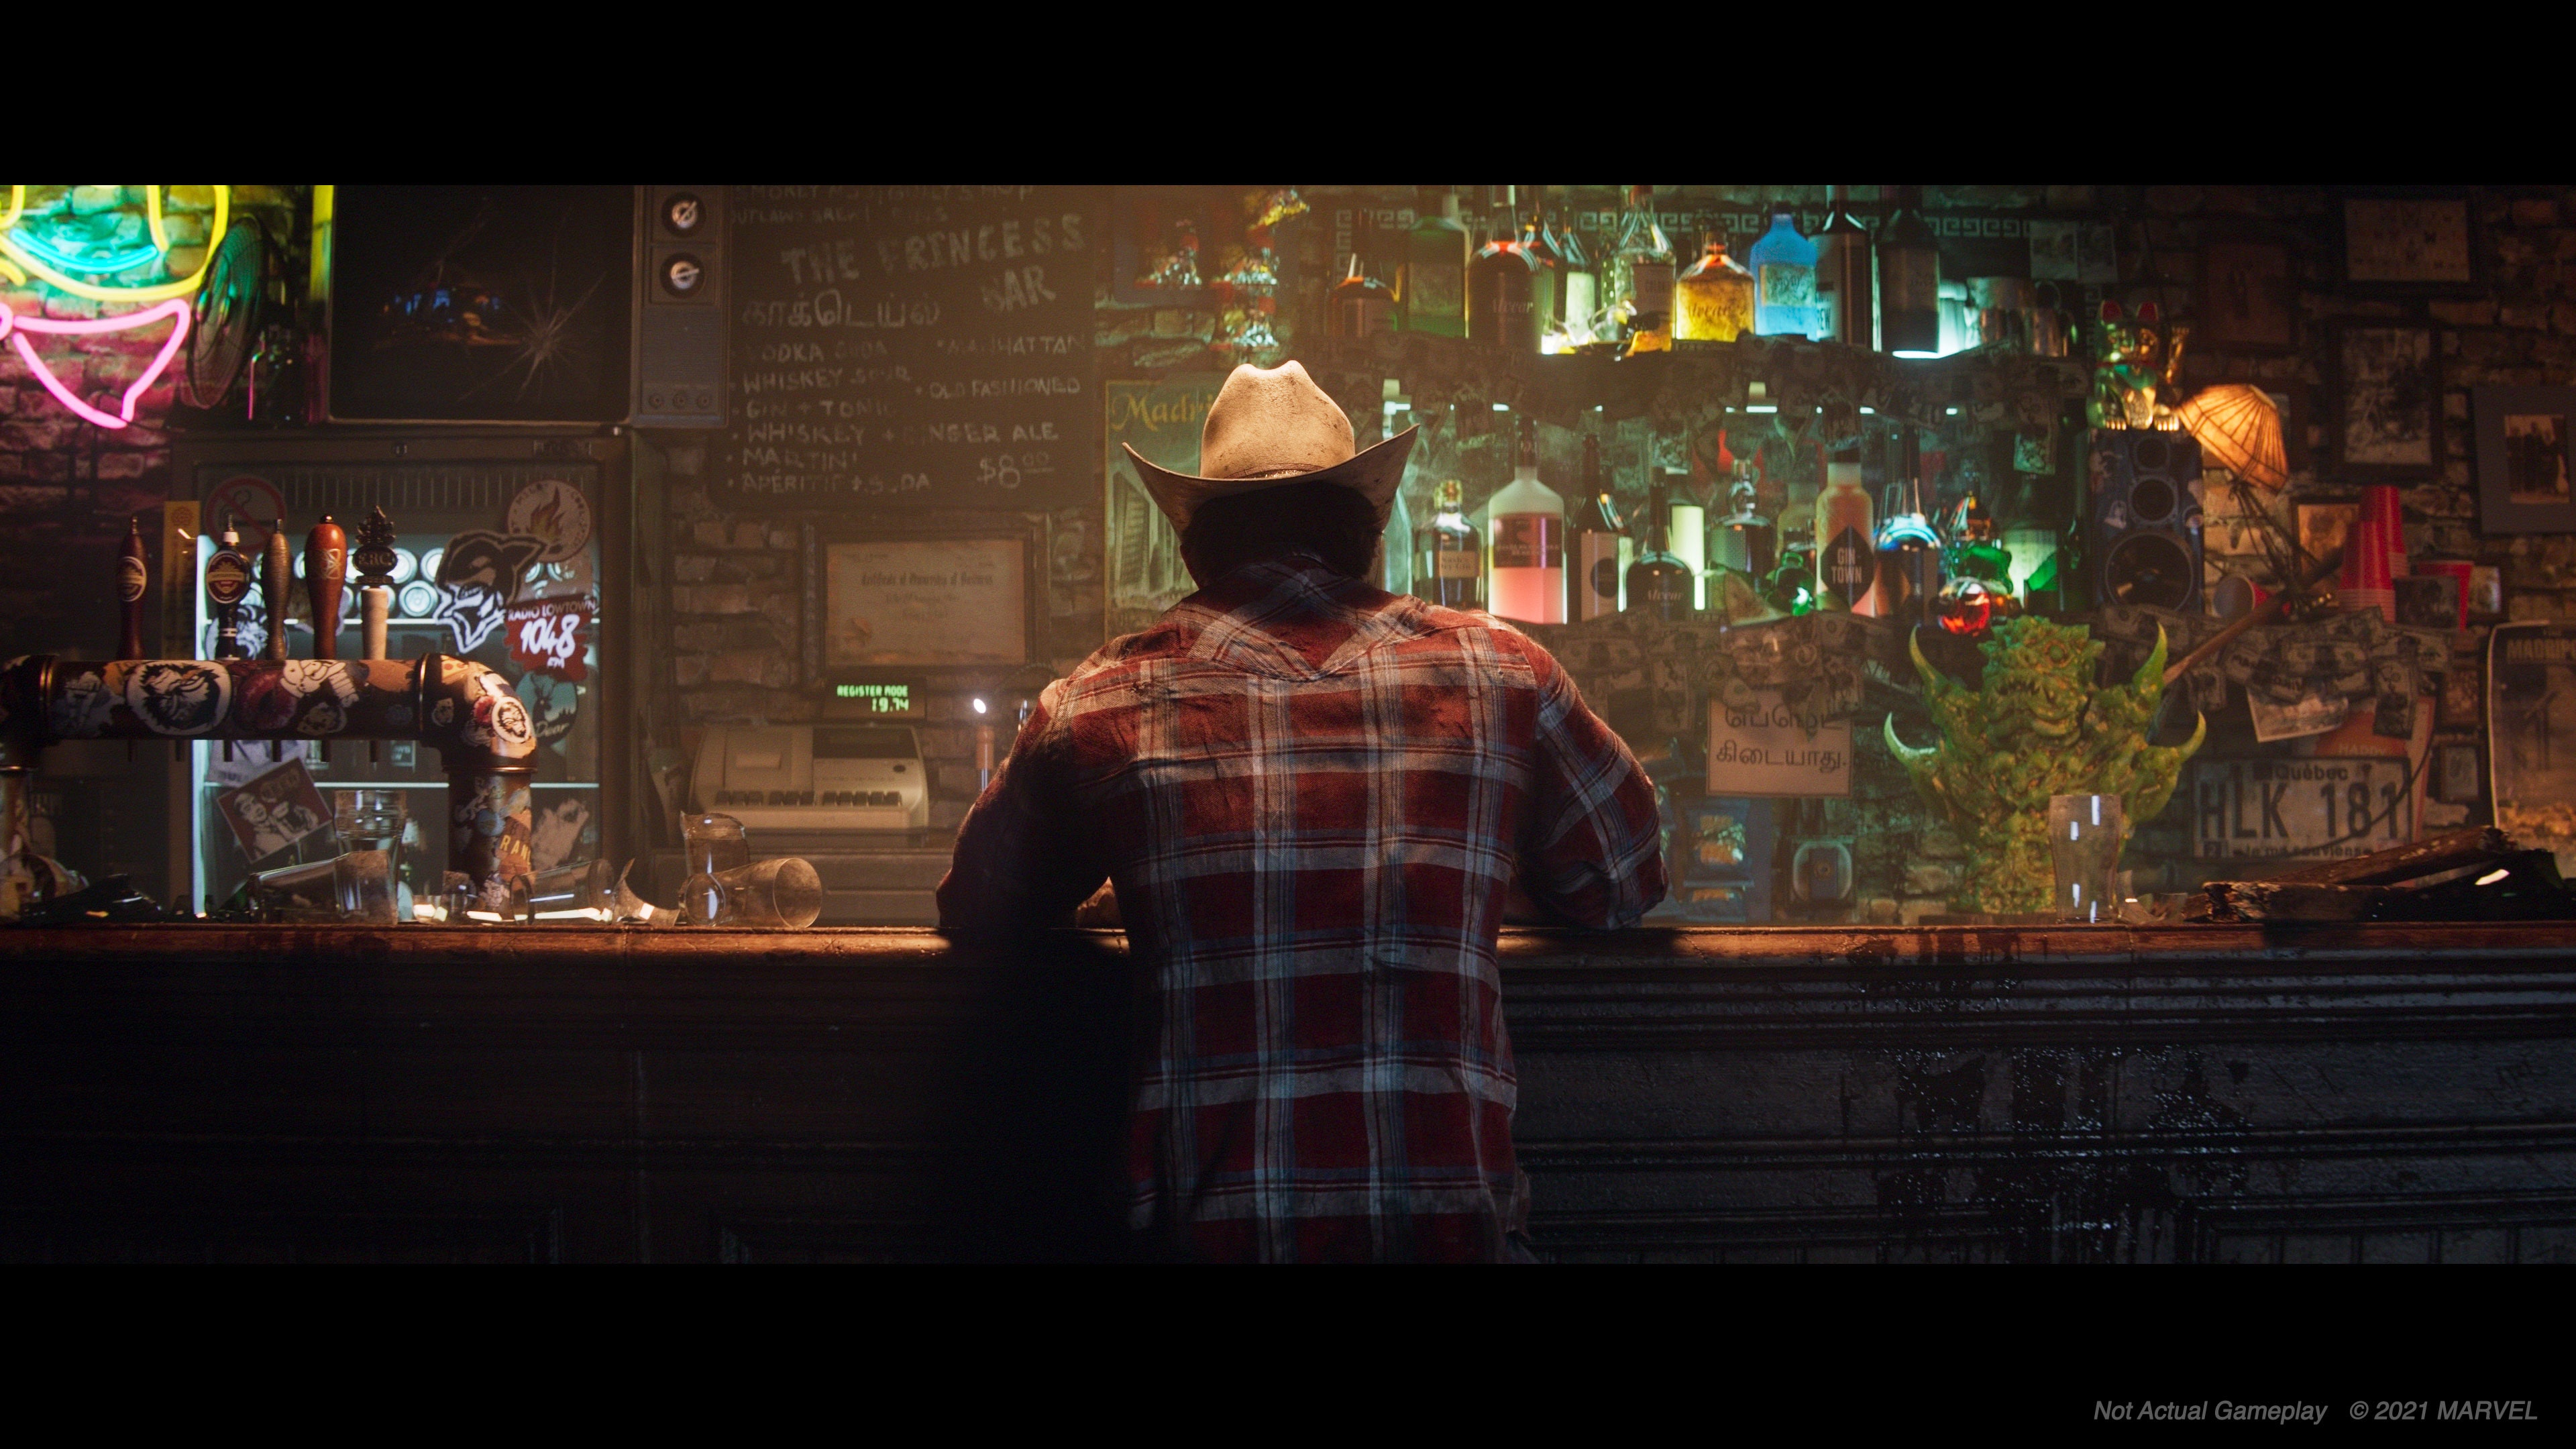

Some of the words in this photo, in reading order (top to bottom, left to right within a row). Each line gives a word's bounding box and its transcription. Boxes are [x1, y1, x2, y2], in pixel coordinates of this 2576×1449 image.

[780, 237, 860, 284] THE
[877, 213, 1085, 276] PRINCESS
[981, 265, 1057, 313] BAR
[743, 367, 844, 394] WHISKEY
[745, 400, 787, 419] GIN
[747, 423, 865, 446] WHISKEY
[1012, 421, 1059, 443] ALE
[1837, 547, 1856, 566] GIN
[1830, 566, 1862, 585] TOWN
[508, 605, 540, 622] RADIO
[541, 599, 596, 618] LOWTOWN
[547, 656, 566, 669] FM
[836, 684, 883, 698] REGISTER
[884, 684, 908, 698] MODE
[871, 696, 910, 712] 19.74
[2200, 782, 2289, 839] HLK
[2320, 782, 2398, 839] 181
